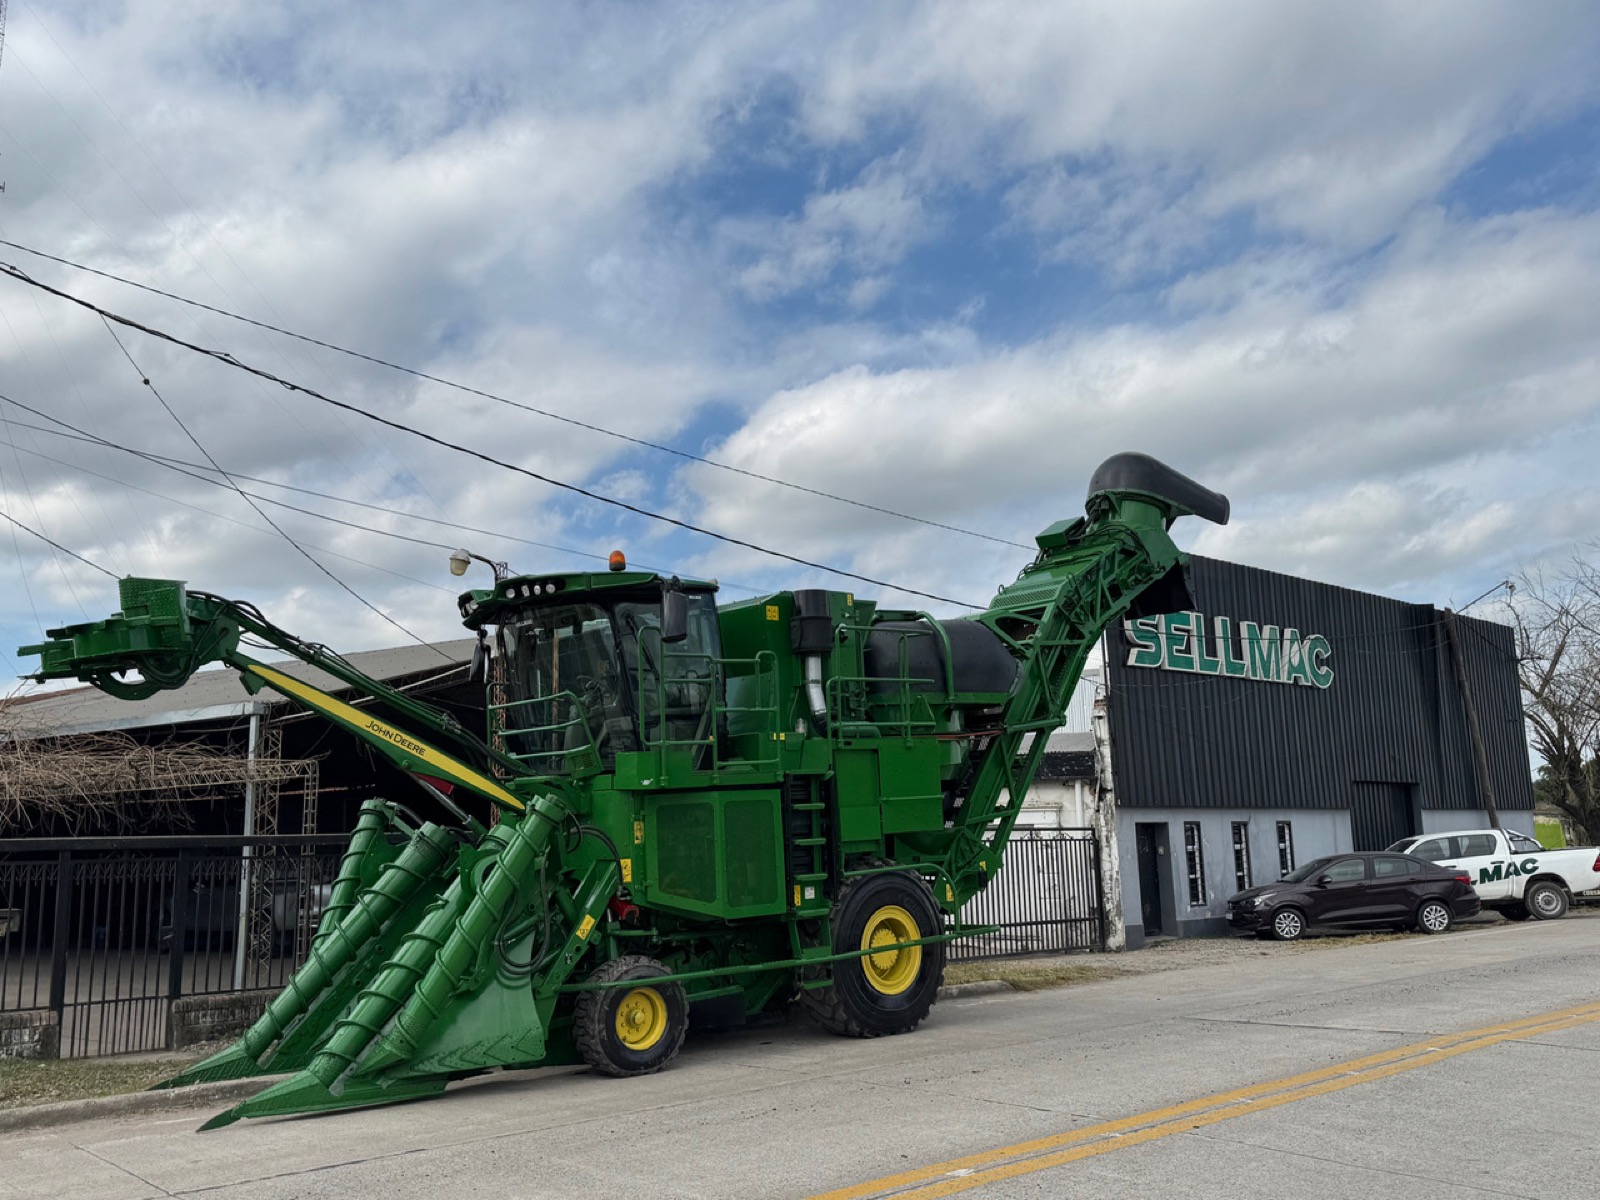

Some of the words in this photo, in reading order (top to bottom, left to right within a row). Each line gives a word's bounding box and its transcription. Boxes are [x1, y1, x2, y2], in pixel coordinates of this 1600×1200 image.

[1124, 611, 1334, 689] SELLMAC
[365, 720, 393, 740] JOHN
[393, 733, 426, 756] DEERE
[1471, 858, 1540, 886] MAC
